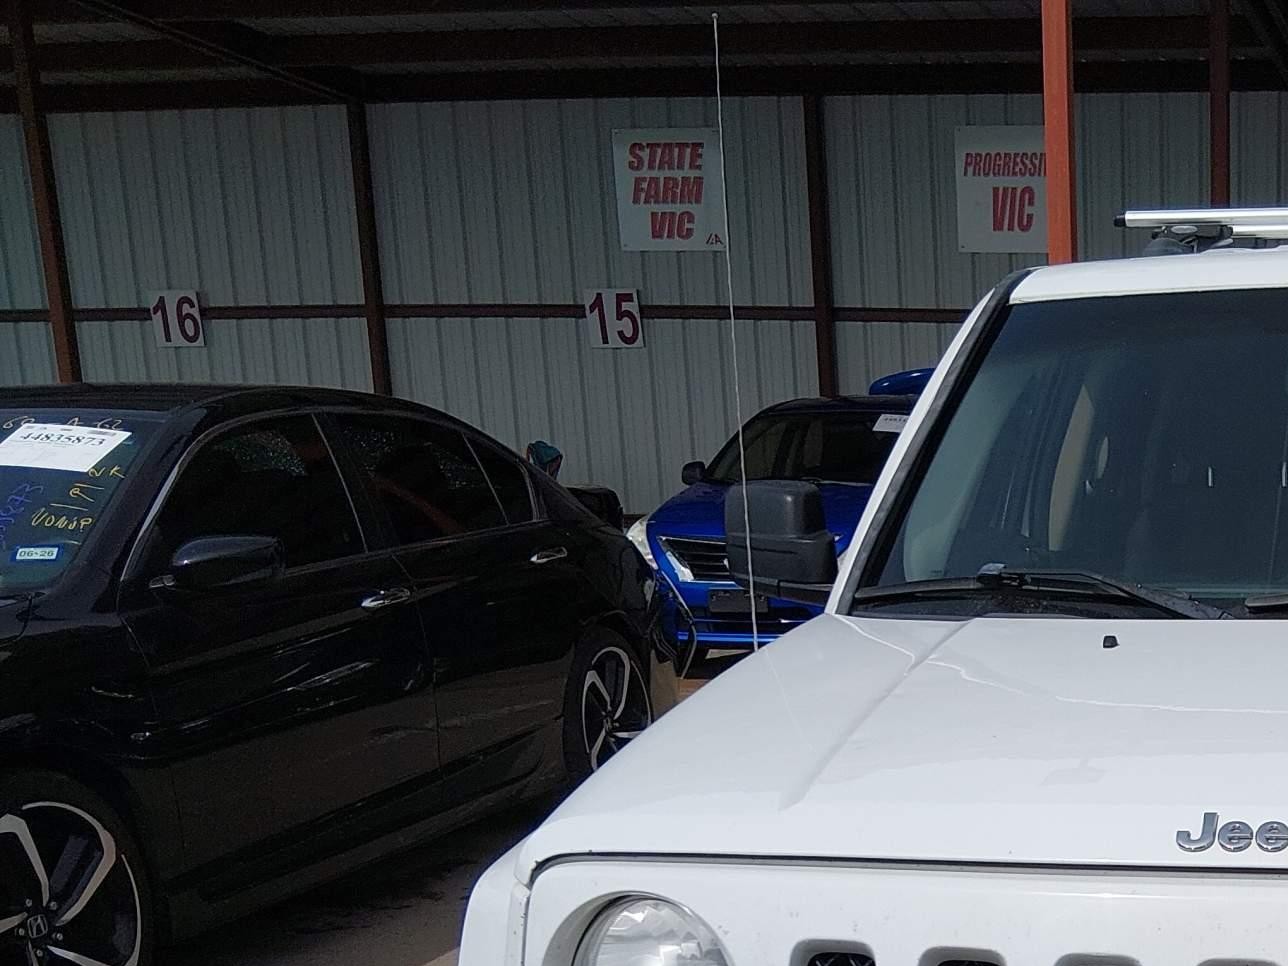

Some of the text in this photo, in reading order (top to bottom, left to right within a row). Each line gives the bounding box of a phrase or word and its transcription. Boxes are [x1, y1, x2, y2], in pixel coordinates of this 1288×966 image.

[628, 142, 704, 171] STATE
[631, 176, 704, 205] FARM
[992, 185, 1035, 232] VIC
[650, 210, 695, 240] VIC
[152, 295, 200, 344] 16
[589, 292, 640, 345] 15
